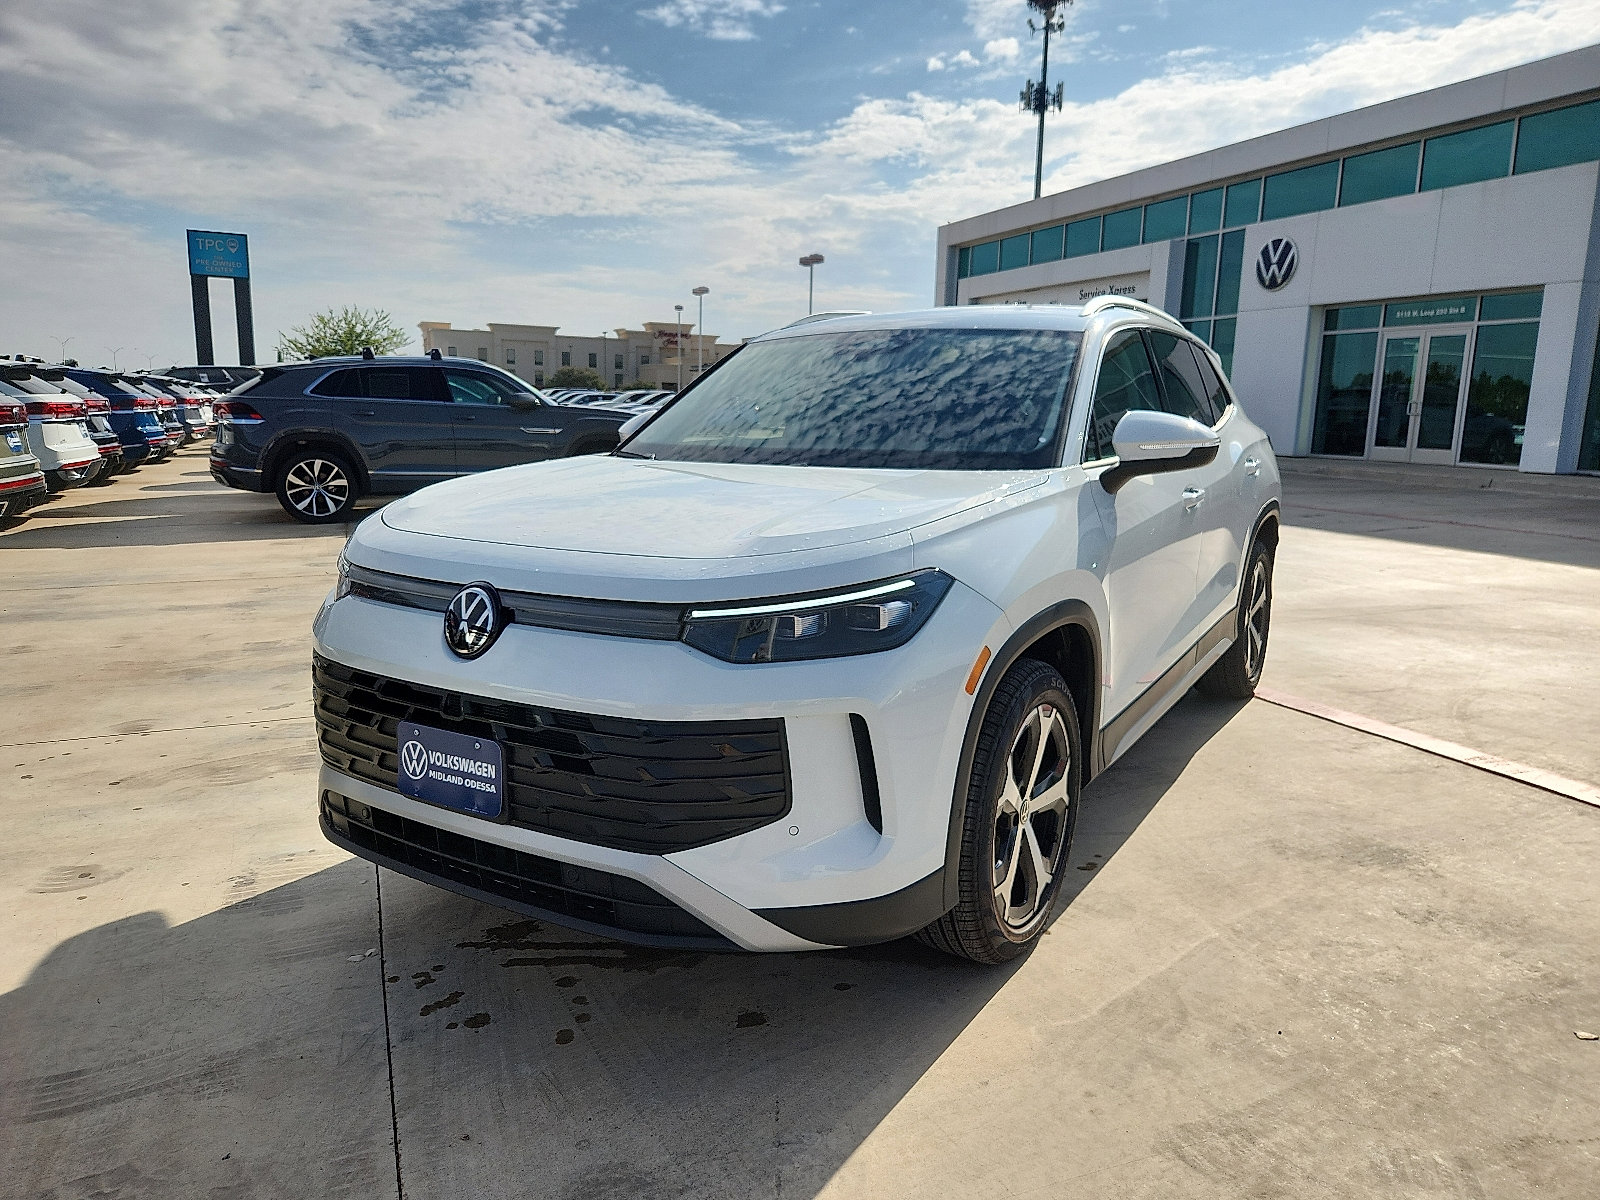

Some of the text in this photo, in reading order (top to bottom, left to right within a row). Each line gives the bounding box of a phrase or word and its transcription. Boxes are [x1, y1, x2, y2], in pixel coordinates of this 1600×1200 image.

[195, 238, 225, 252] TPC
[1079, 285, 1136, 300] Service Xpress
[1420, 309, 1435, 317] Loop
[428, 750, 496, 779] VOLKSWAGEN
[428, 769, 497, 794] MIDLAND ODESSA
